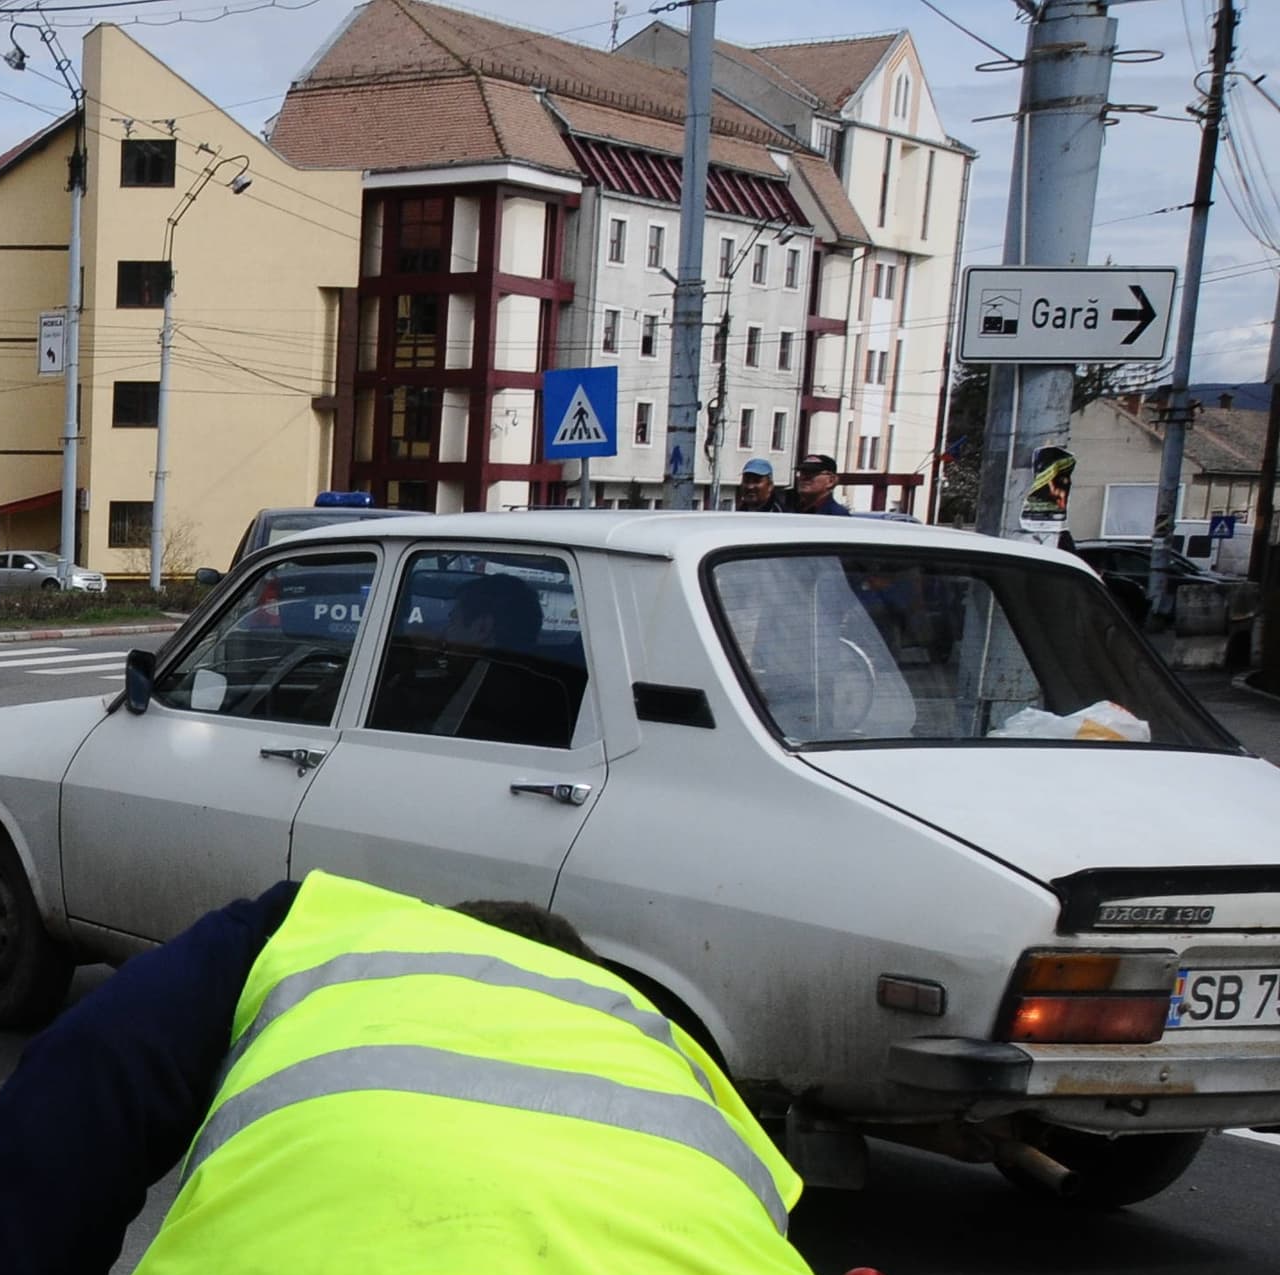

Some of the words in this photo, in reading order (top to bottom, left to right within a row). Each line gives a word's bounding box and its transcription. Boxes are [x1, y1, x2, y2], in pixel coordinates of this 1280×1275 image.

[1032, 298, 1099, 330] Gară
[314, 603, 423, 623] POLA
[1099, 907, 1168, 921] DACIA
[1190, 975, 1244, 1020] SB
[1254, 974, 1280, 1020] 7
